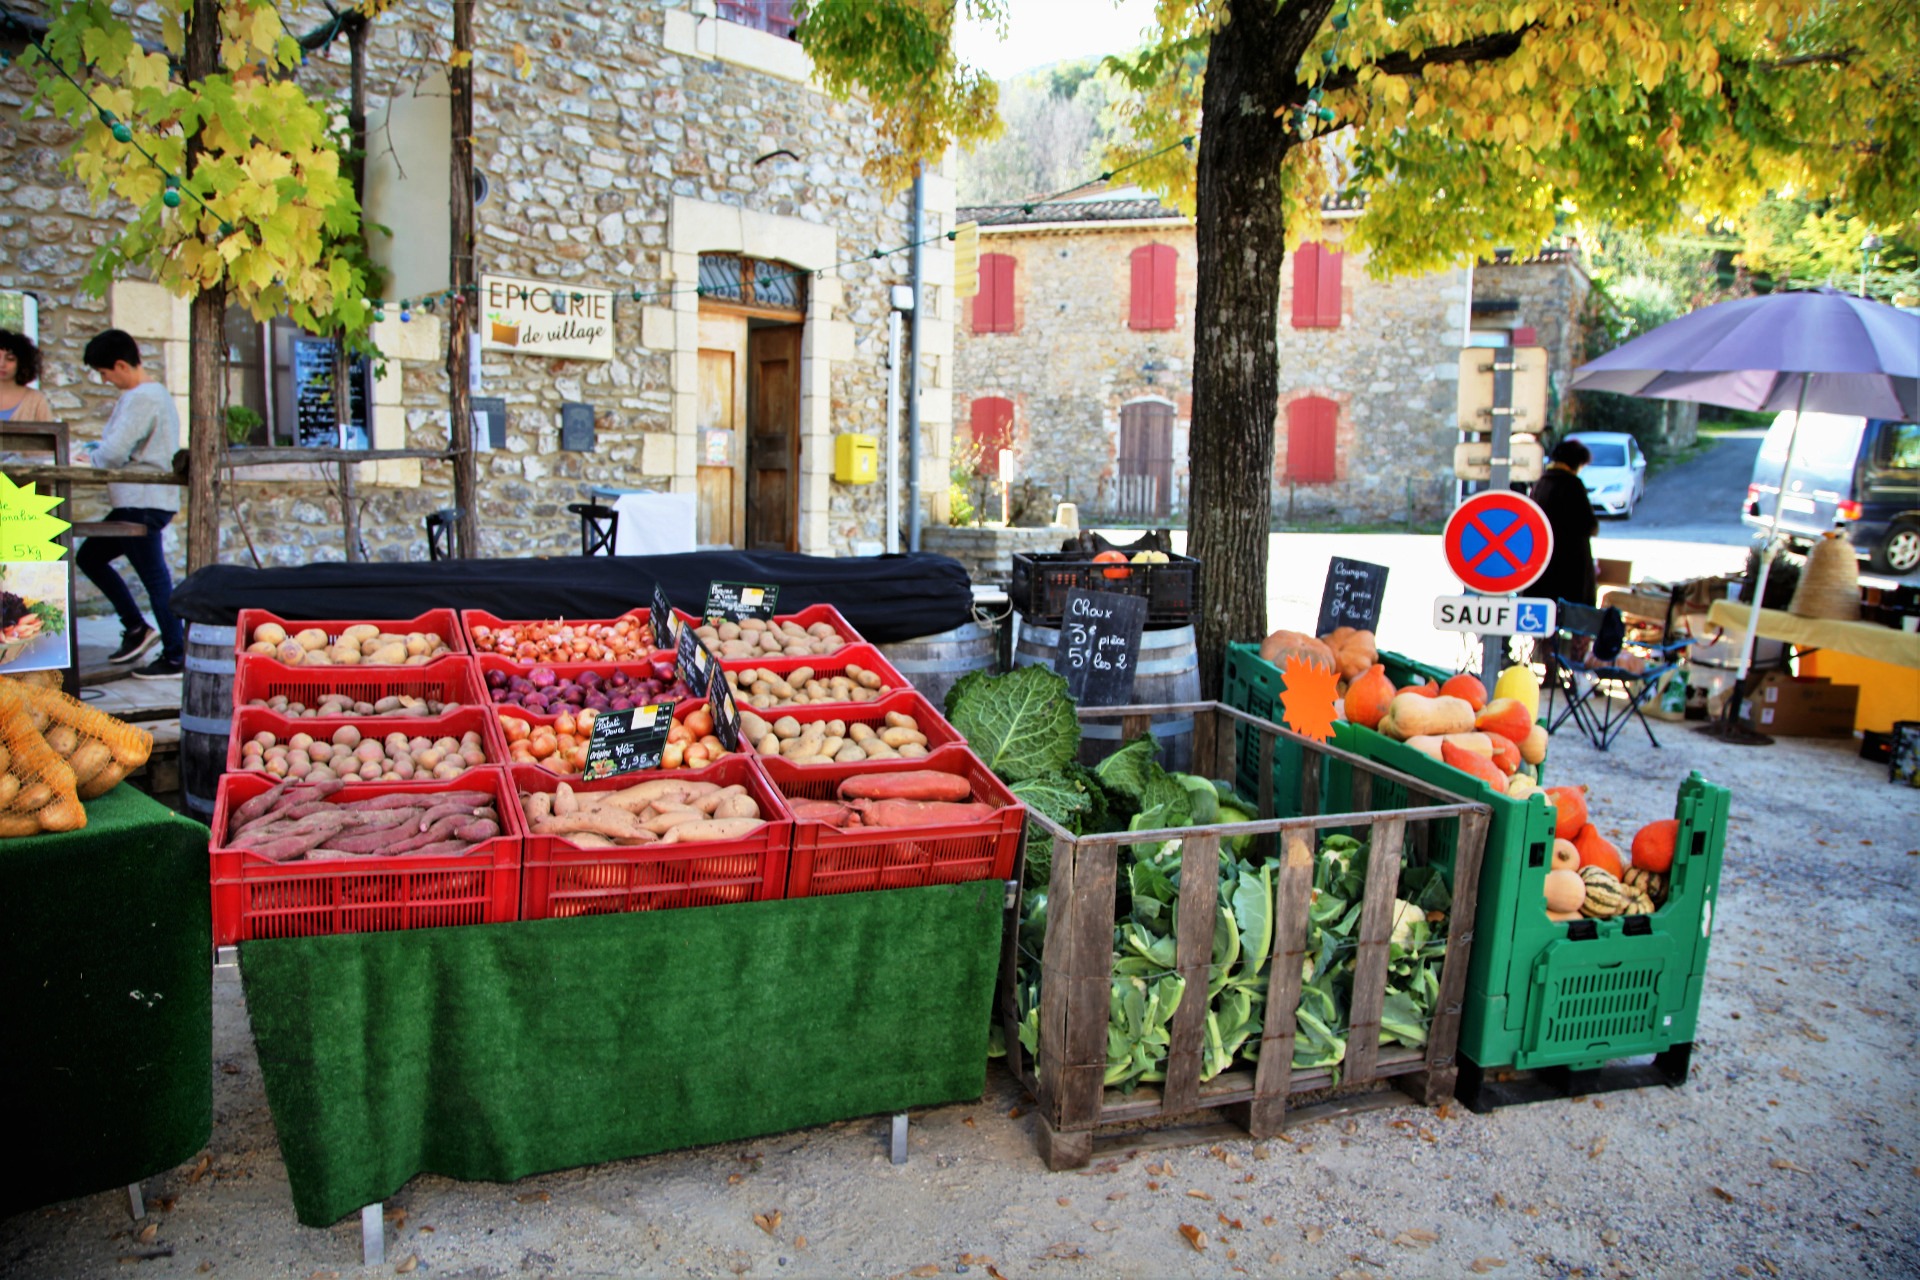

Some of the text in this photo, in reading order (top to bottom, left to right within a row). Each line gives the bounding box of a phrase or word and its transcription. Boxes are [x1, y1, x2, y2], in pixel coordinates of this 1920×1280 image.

[489, 281, 606, 320] EPICRIE
[522, 319, 605, 345] de village
[1071, 598, 1113, 618] Choux
[1441, 604, 1510, 626] SAUF
[1093, 652, 1112, 670] les
[1115, 652, 1128, 670] 2
